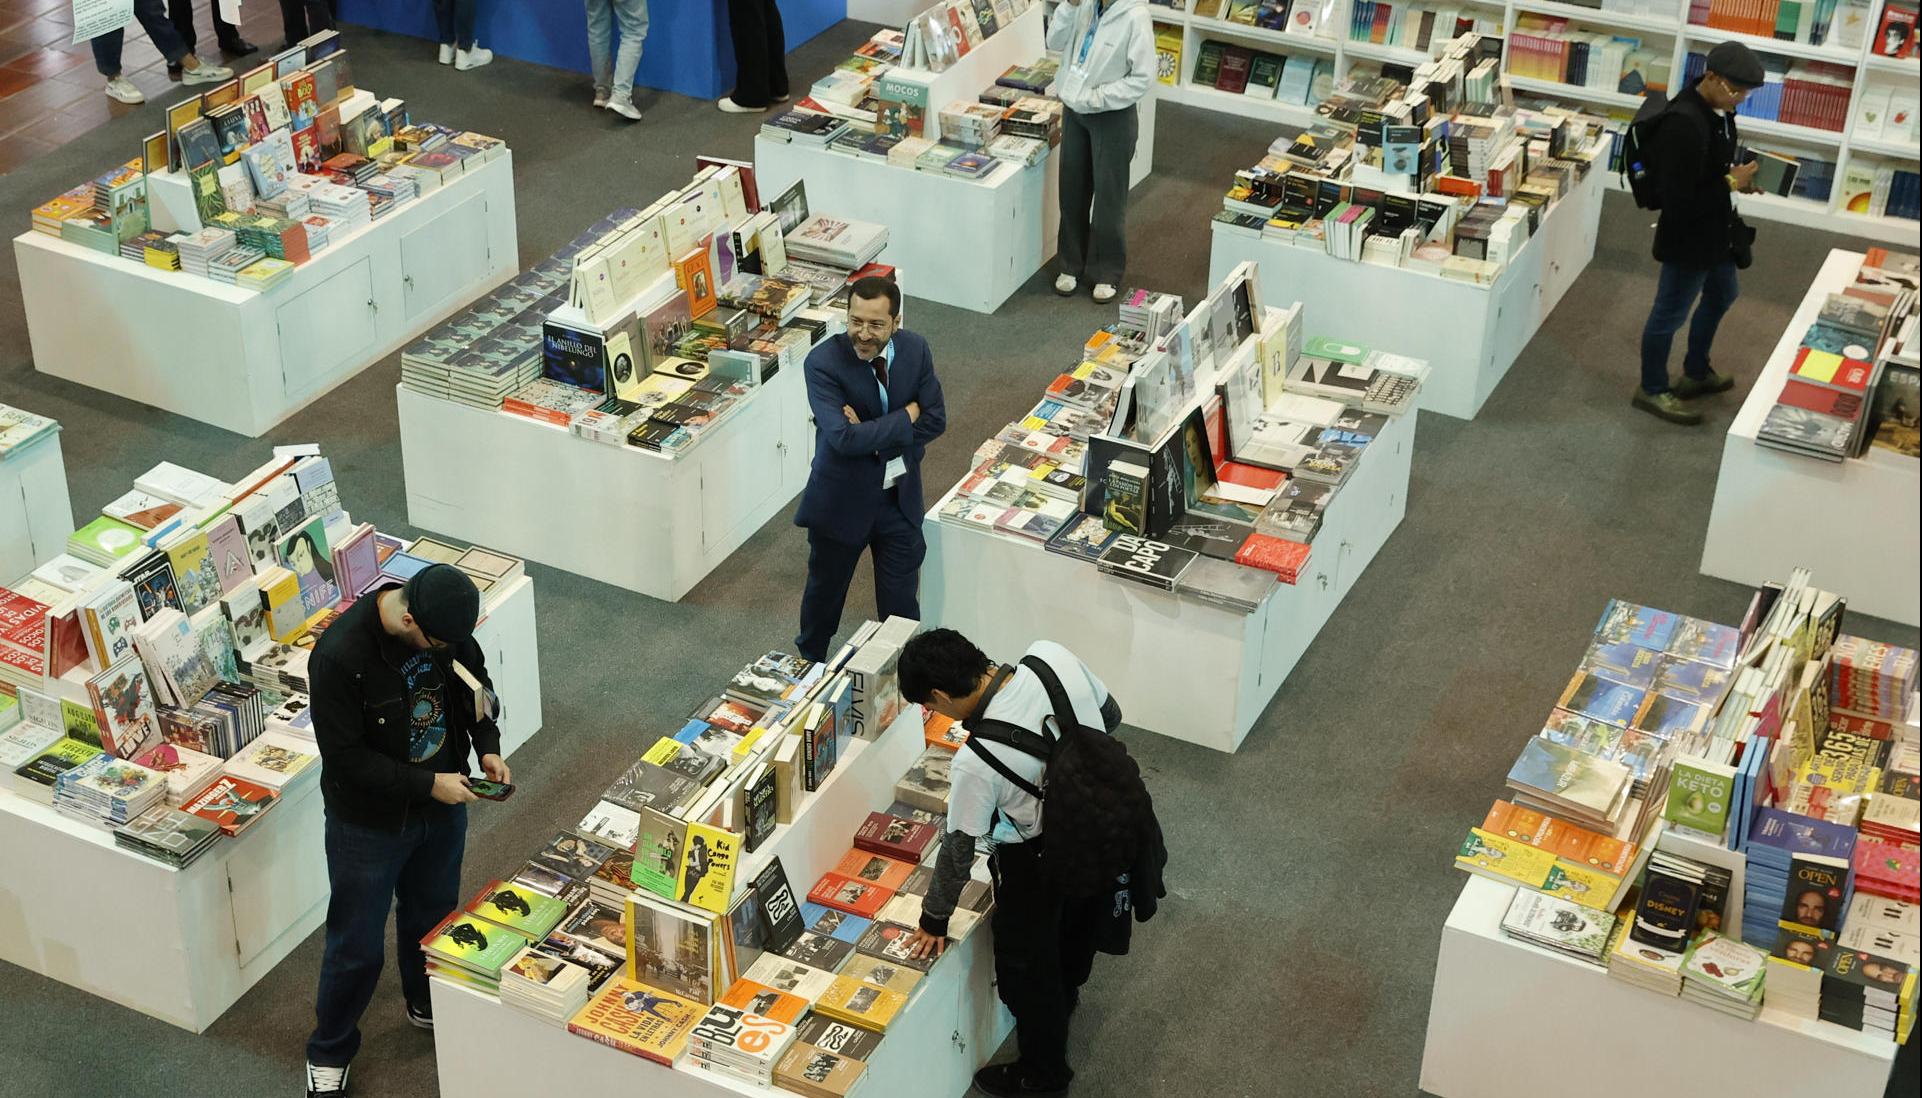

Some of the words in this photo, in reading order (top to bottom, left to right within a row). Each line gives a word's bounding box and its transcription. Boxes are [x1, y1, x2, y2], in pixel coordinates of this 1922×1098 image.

[885, 83, 919, 97] MOCOS
[551, 341, 594, 358] NIBELUNGO
[556, 338, 583, 349] ANILLO
[584, 344, 598, 354] DEL
[1113, 533, 1146, 553] DA
[1124, 541, 1170, 572] CAPO
[8, 604, 46, 627] VIDAS
[1864, 644, 1889, 668] ERES
[846, 667, 865, 736] ELVIS
[1820, 730, 1857, 761] 365
[1677, 777, 1723, 798] KETO
[1679, 769, 1692, 779] LA
[1694, 774, 1725, 788] DIETA
[186, 786, 227, 815] MAZINGER
[707, 848, 730, 861] Congo
[716, 839, 730, 851] Kid
[708, 858, 731, 871] Powers
[1798, 868, 1837, 886] OPEN
[1647, 900, 1686, 917] DISNEY
[585, 984, 629, 1024] JOHNNY
[600, 1005, 645, 1034] CASH
[629, 1030, 641, 1039] LA
[637, 1016, 655, 1034] VIDA
[658, 1027, 677, 1048] JOHNNY
[675, 1013, 691, 1029] CASH
[691, 1006, 744, 1046] BLU
[594, 1034, 616, 1048] CASH
[639, 1035, 648, 1043] EN
[646, 1020, 665, 1038] LETRAS
